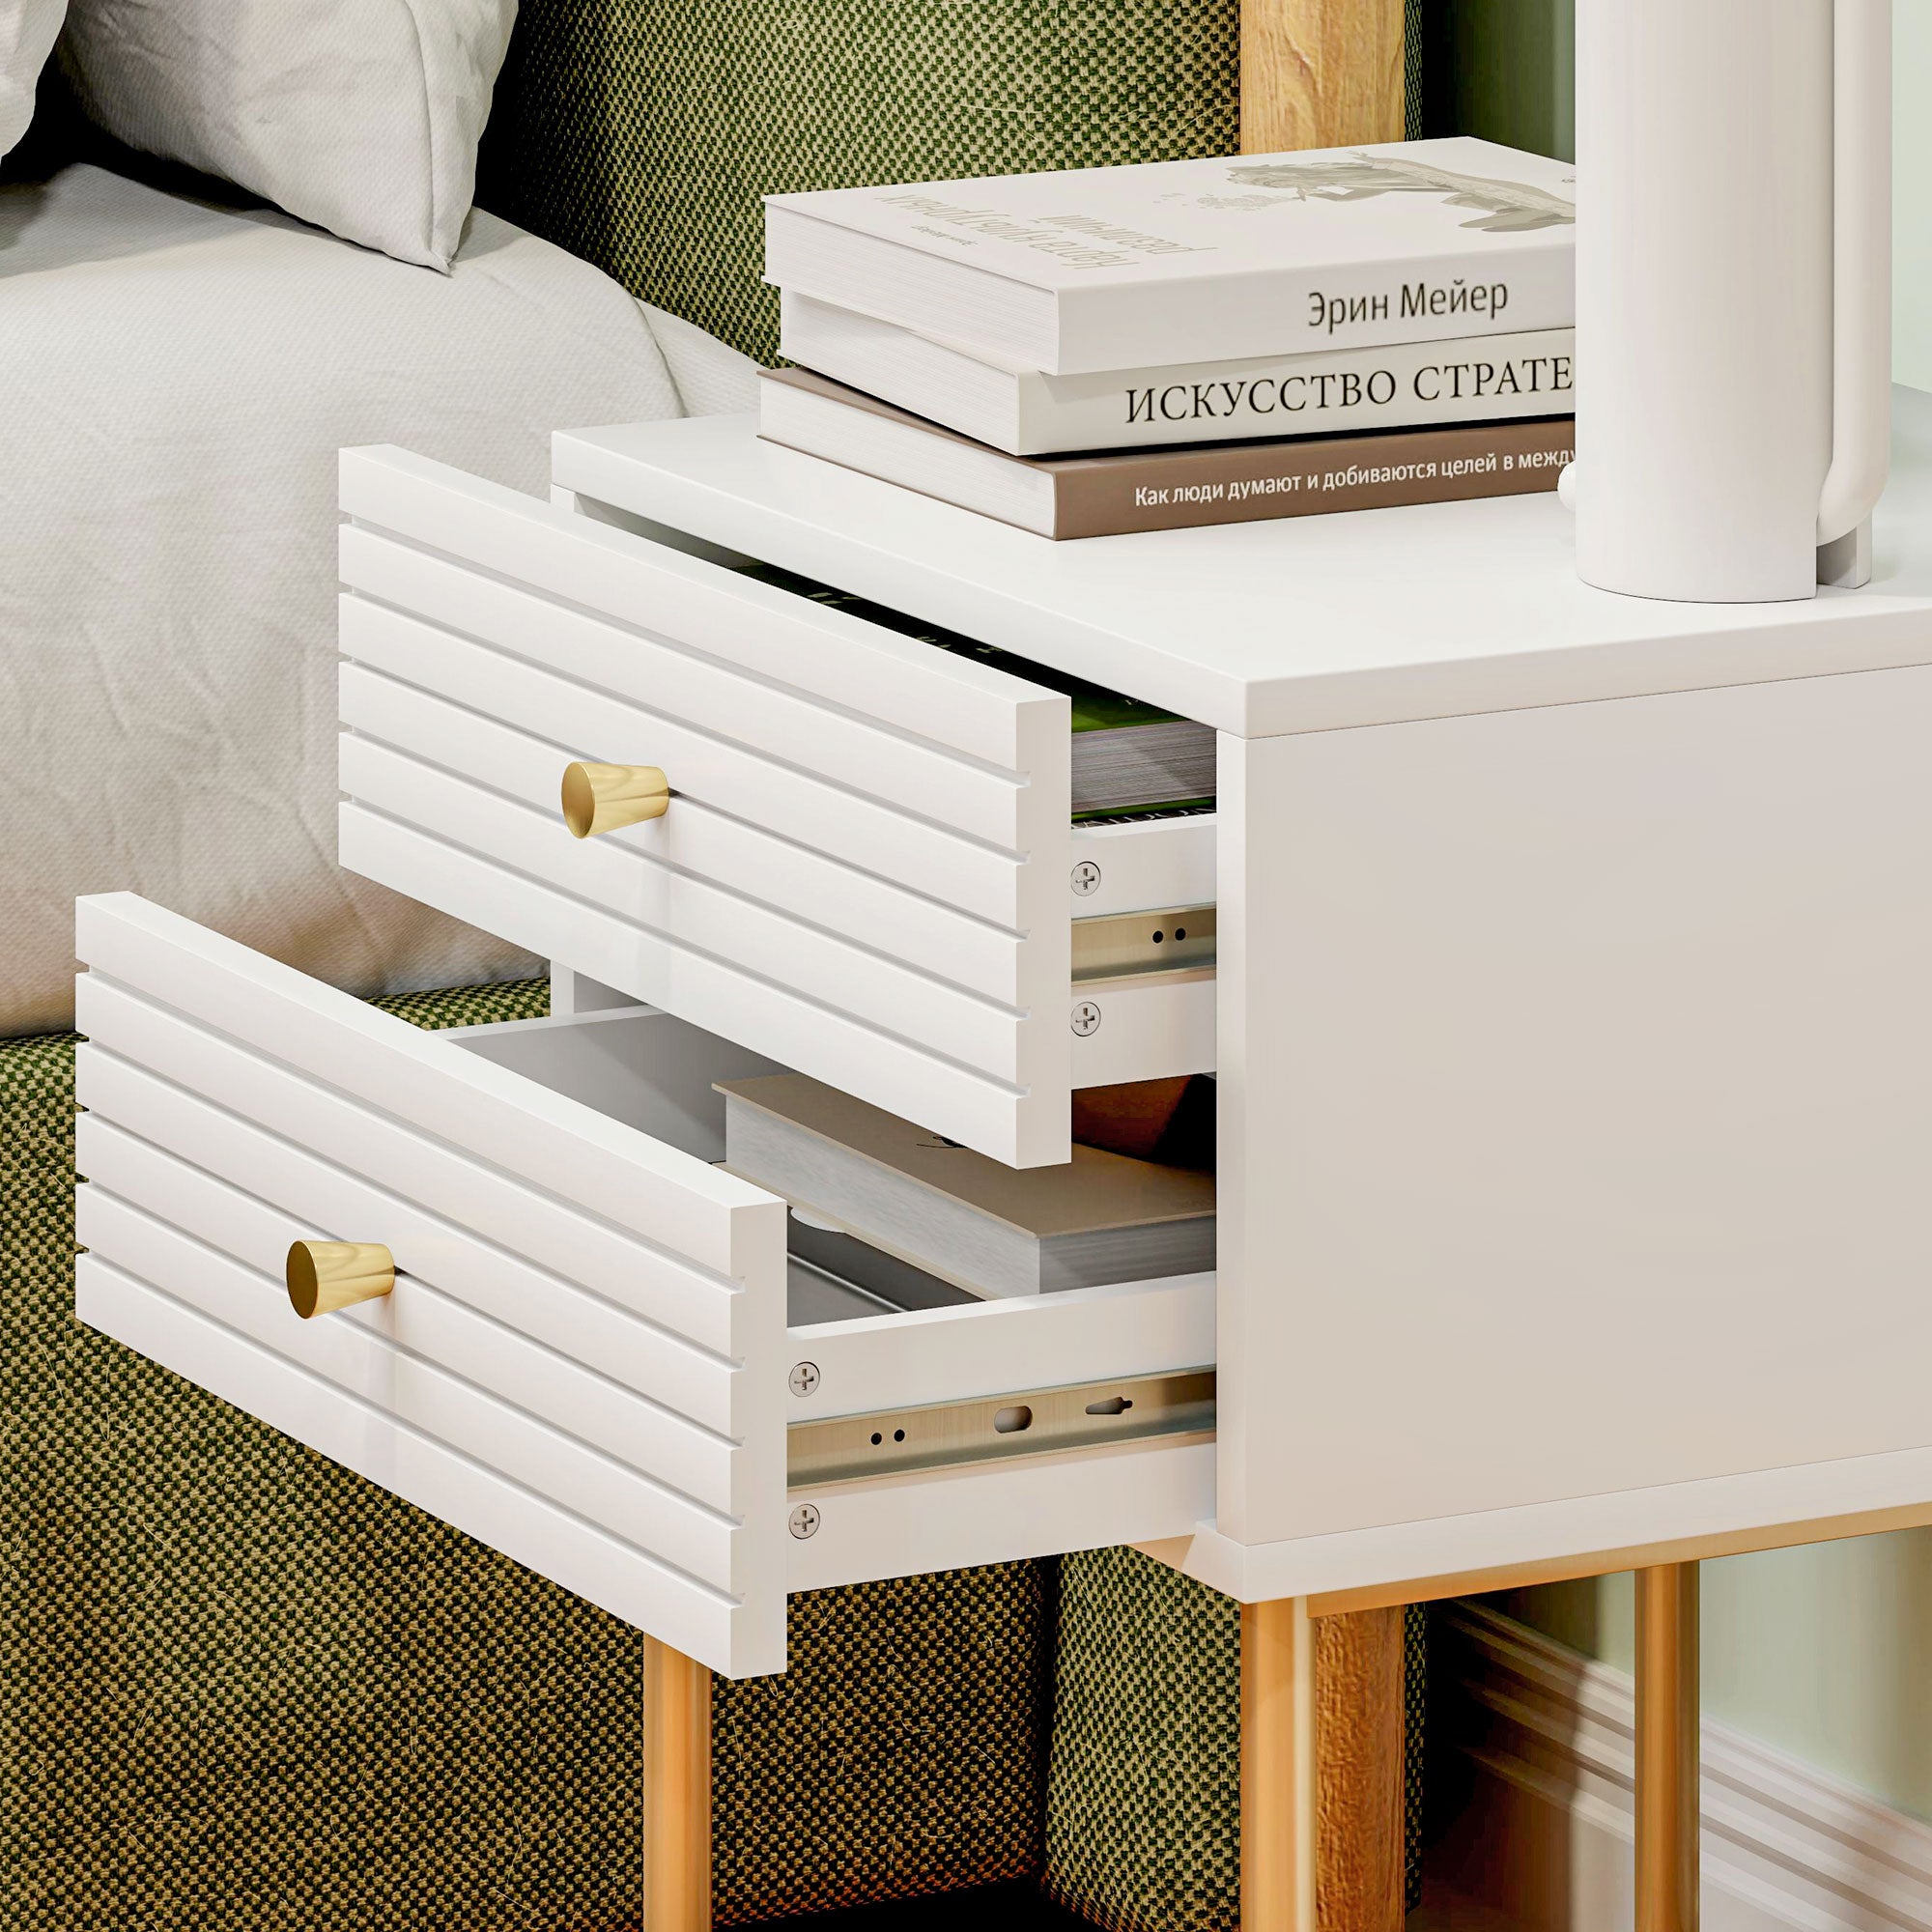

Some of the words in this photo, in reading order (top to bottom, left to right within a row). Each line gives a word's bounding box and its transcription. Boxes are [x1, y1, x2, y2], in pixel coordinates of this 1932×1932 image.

[873, 194, 1064, 242] культурных
[1027, 214, 1218, 255] различий
[1032, 241, 1140, 270] Карта
[1308, 292, 1389, 334] Эрин
[1400, 279, 1509, 319] Мейер
[1125, 370, 1397, 424] ИСКУССТВО
[1413, 356, 1574, 401] СТРАТЕ
[1135, 486, 1169, 506] Как
[1172, 484, 1224, 503] люди
[1227, 475, 1302, 500] думают
[1307, 474, 1319, 490] и
[1321, 462, 1437, 491] добиваются
[1441, 452, 1497, 478] целей
[1503, 455, 1515, 471] в
